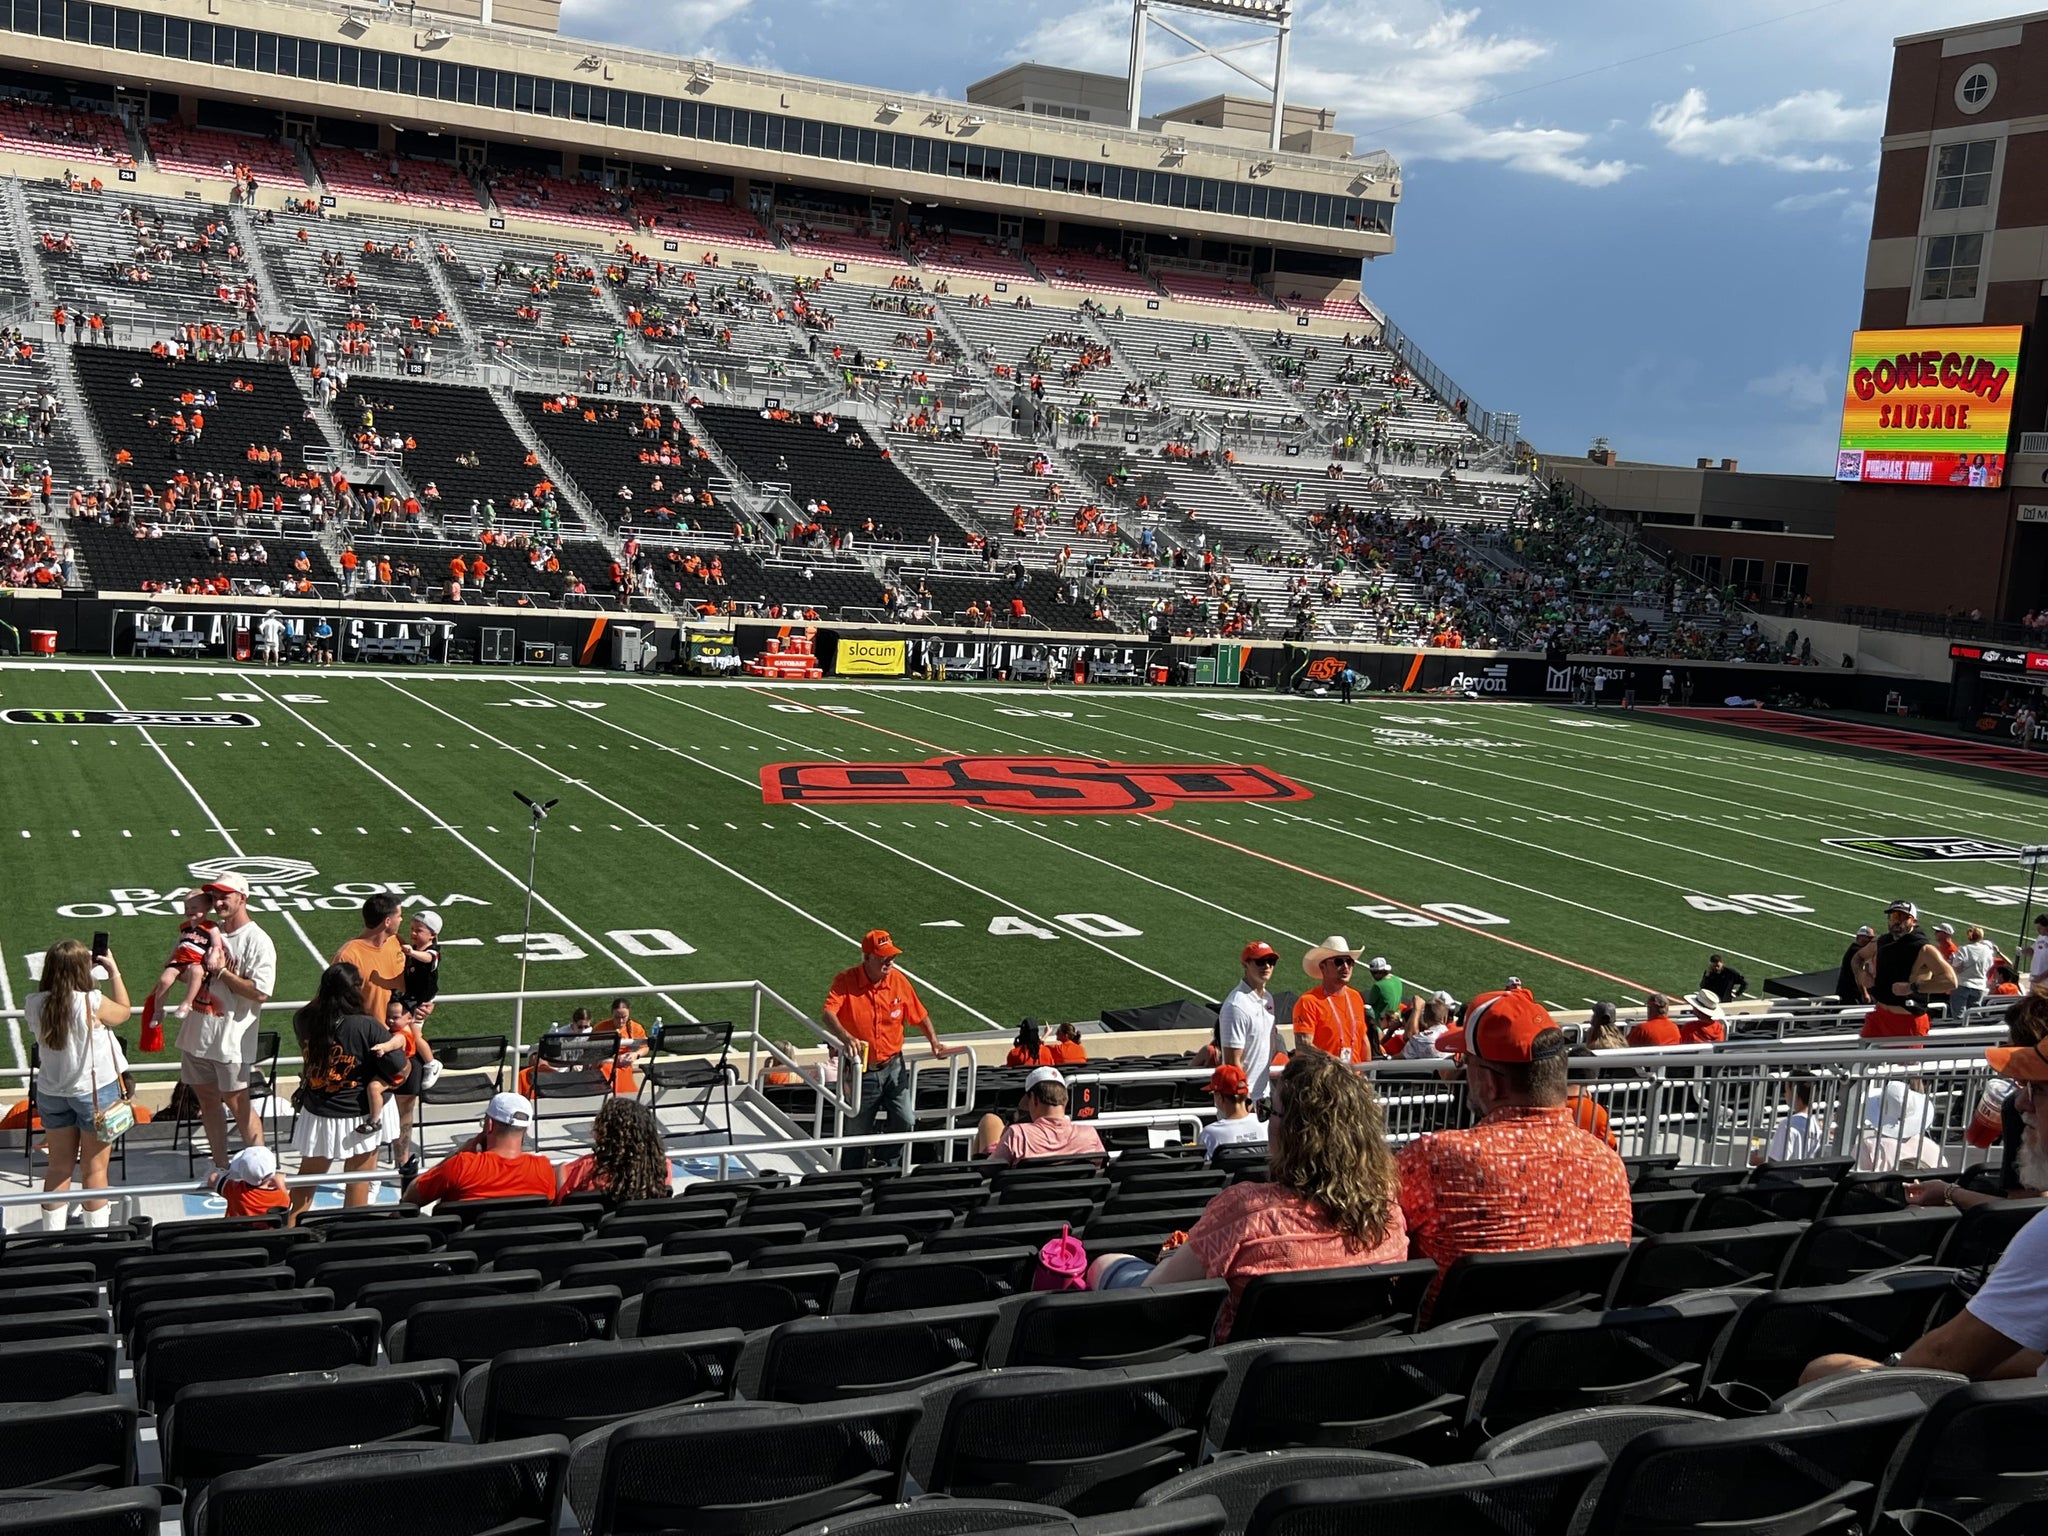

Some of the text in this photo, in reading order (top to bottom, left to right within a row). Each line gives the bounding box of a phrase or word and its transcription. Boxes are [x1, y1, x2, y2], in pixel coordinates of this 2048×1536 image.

[121, 171, 134, 180] 234
[322, 197, 334, 205] 235
[410, 364, 422, 373] 135
[1854, 350, 2009, 402] CONECUH
[1879, 404, 1969, 429] SAUSAGE
[848, 642, 896, 658] slocum
[1451, 671, 1507, 692] devon
[333, 880, 416, 896] OF
[1083, 1088, 1090, 1103] 6
[1980, 1103, 1992, 1118] TEA
